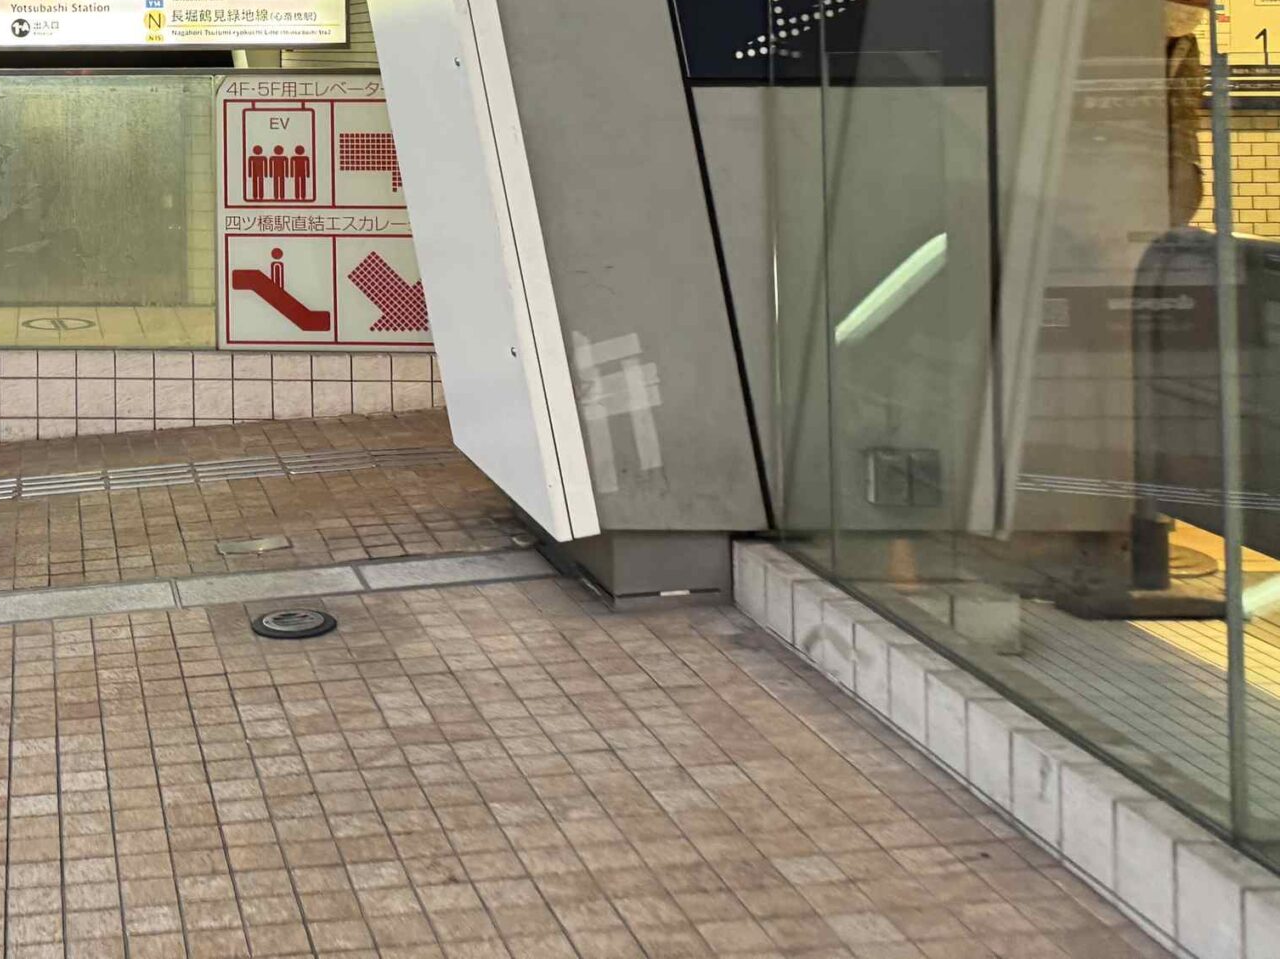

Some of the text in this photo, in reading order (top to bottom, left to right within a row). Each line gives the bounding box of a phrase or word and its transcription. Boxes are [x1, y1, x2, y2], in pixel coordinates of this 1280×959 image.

[10, 2, 110, 13] Yotsubashi Station
[33, 20, 60, 30] 出入口
[148, 12, 161, 29] N
[269, 117, 290, 130] EV
[225, 215, 412, 233] 四ツ橋駅直結エスカレー
